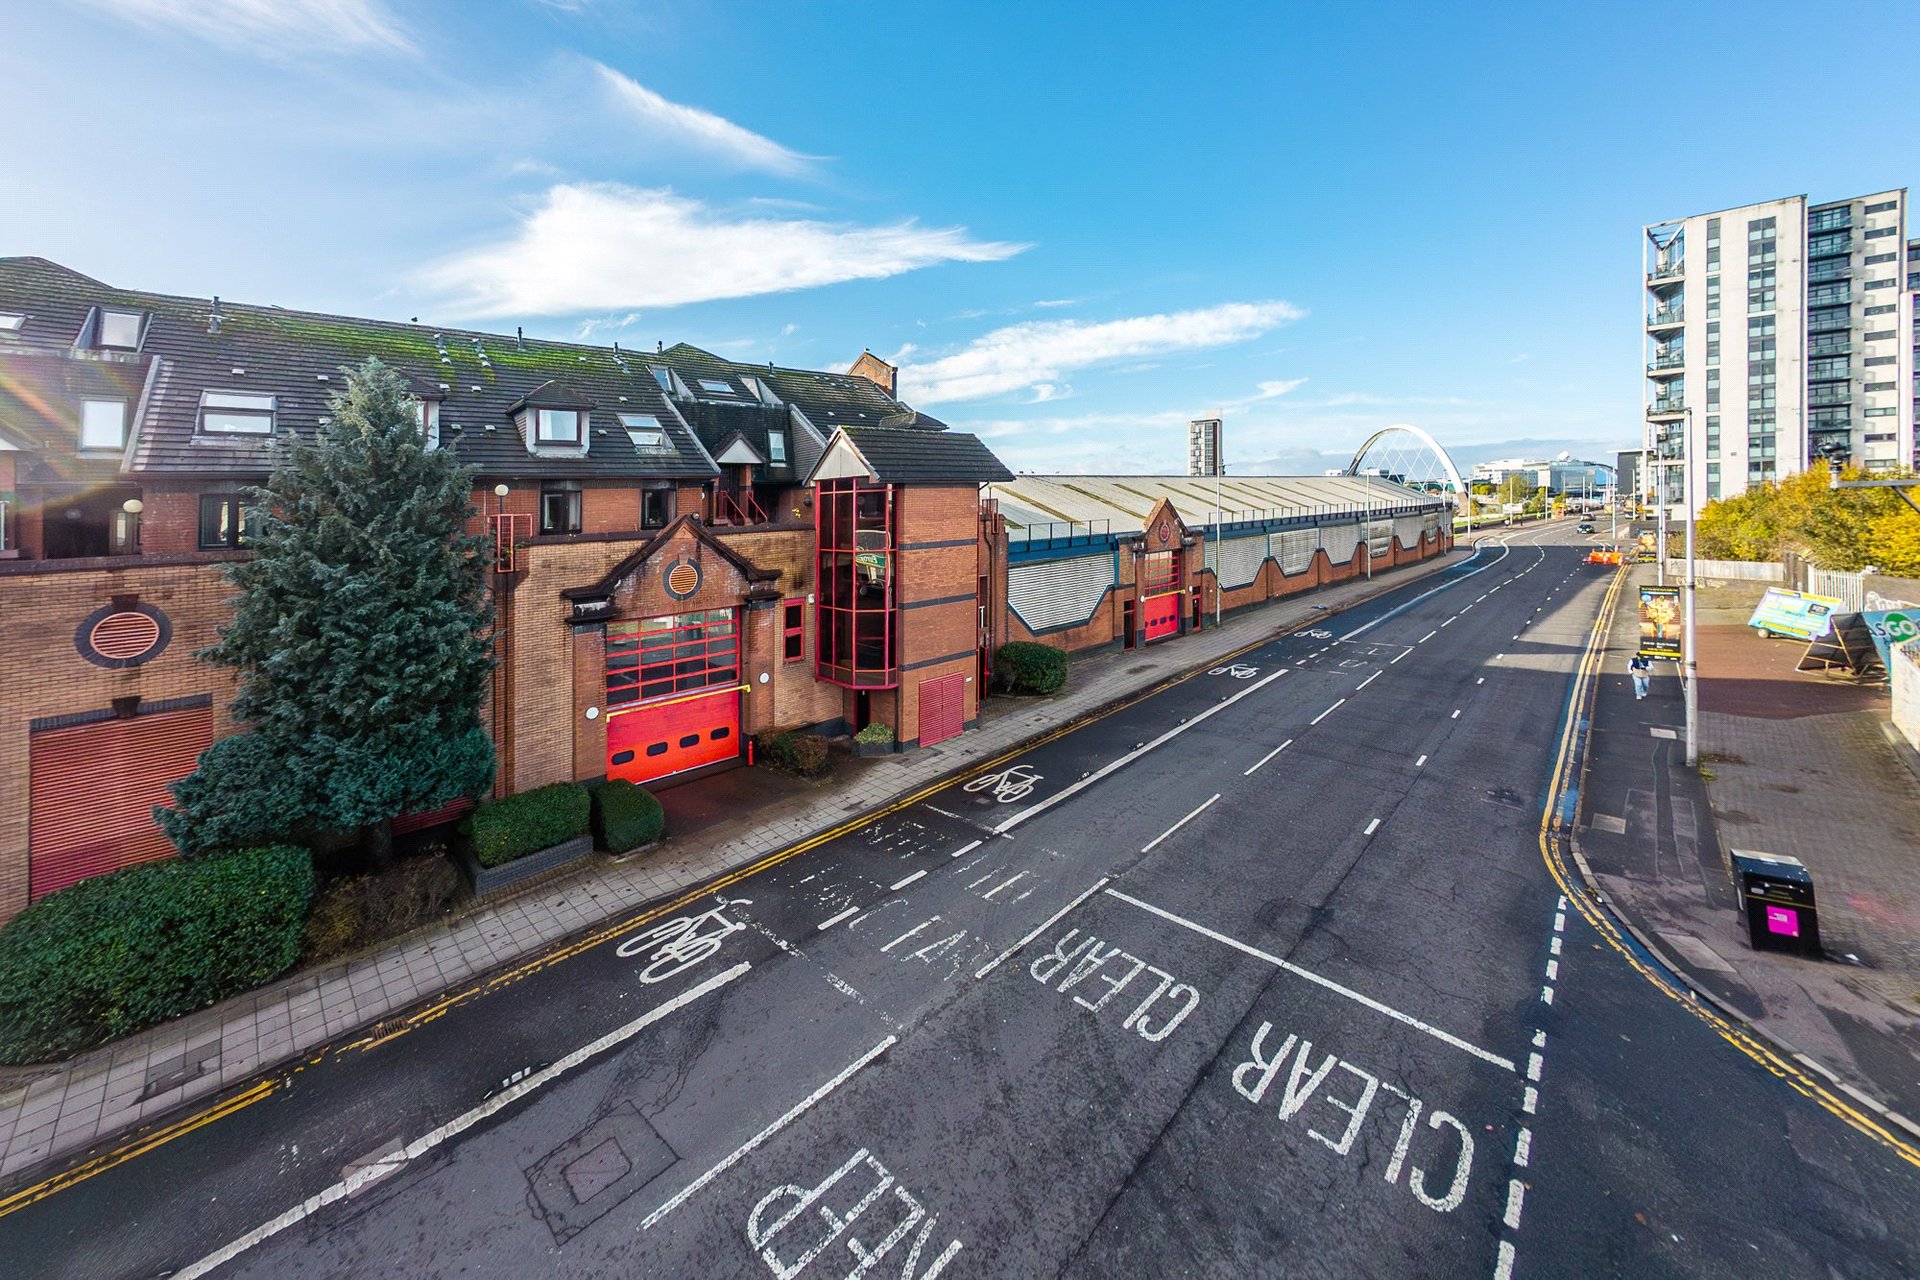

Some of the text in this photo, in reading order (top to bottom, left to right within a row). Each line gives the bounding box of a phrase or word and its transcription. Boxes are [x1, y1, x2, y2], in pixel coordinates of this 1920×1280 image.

[1867, 620, 1920, 637] ASGO
[1030, 928, 1199, 1041] CLEAR
[1232, 1021, 1474, 1212] CLEAR
